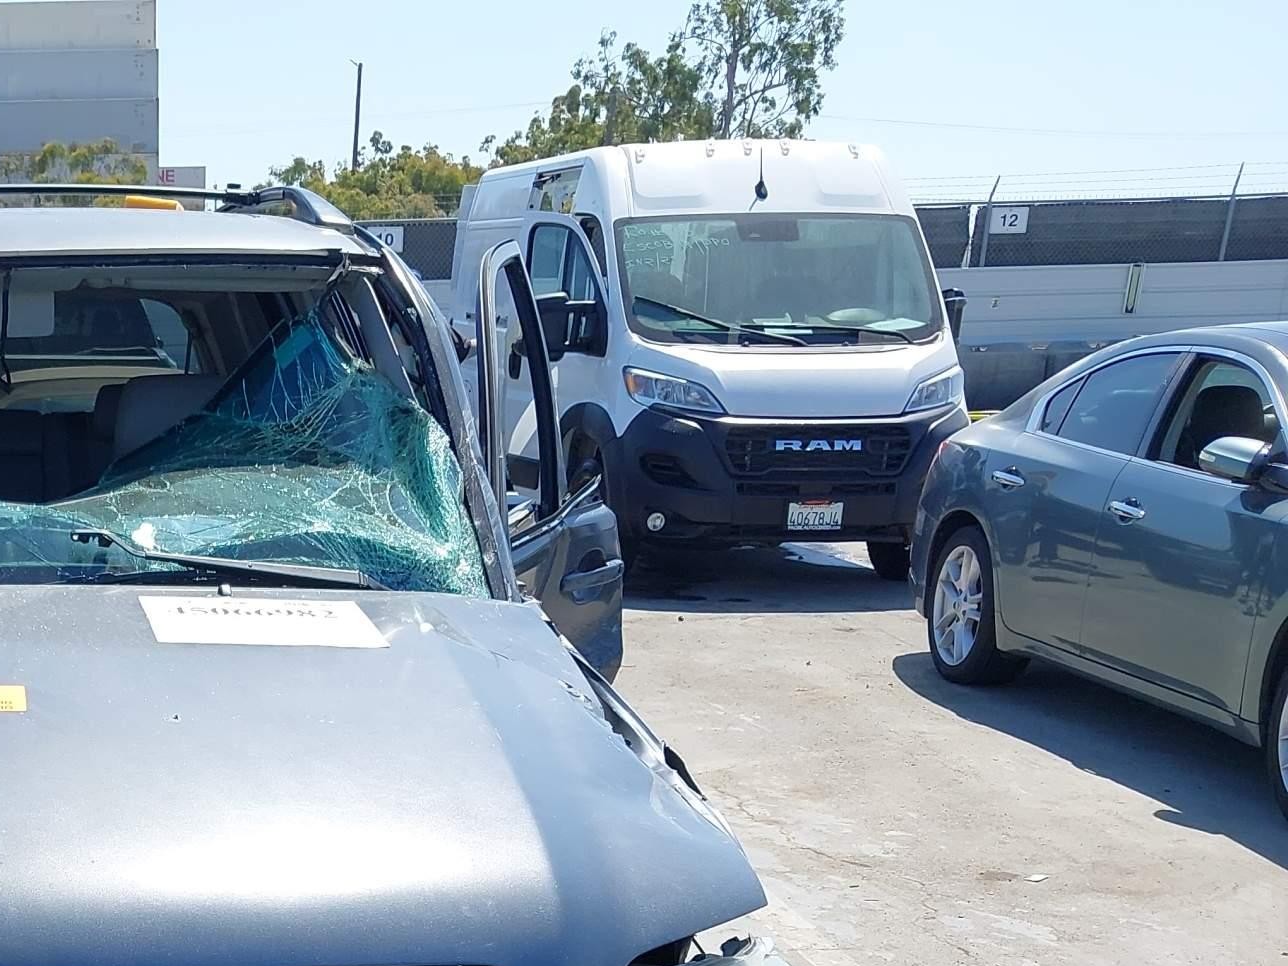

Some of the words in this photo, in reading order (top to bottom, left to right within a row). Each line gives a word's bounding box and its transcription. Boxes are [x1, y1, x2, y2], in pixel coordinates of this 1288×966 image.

[1000, 213, 1019, 227] 12
[376, 232, 394, 246] 10
[775, 439, 862, 451] RAM
[789, 511, 839, 527] 40678J4
